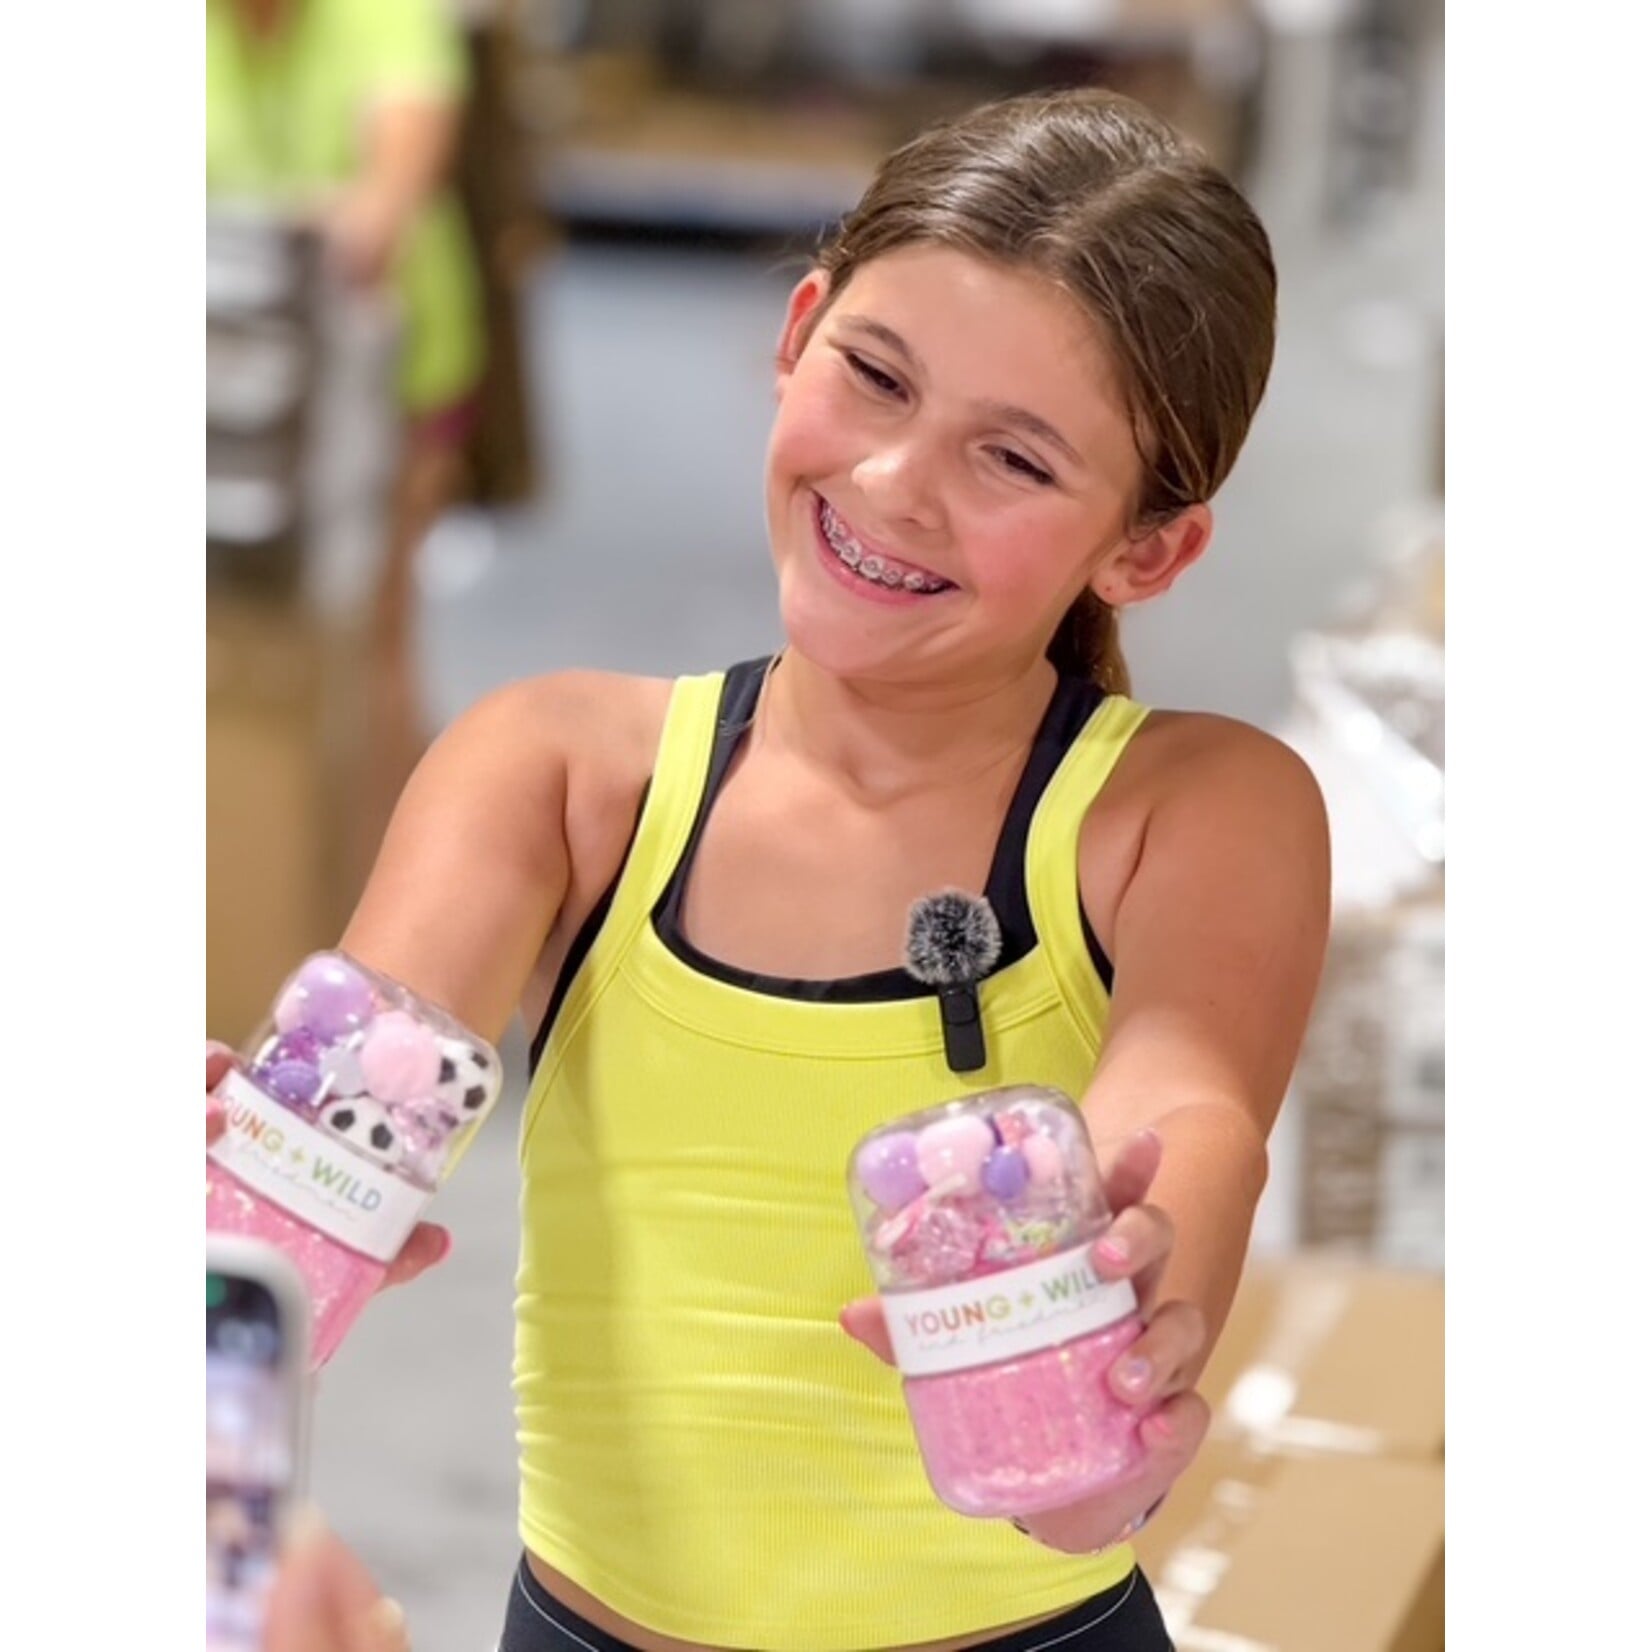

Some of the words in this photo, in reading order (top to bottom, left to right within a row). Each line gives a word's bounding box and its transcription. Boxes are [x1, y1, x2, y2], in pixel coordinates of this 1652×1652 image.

[311, 1156, 382, 1211] WILD
[904, 1293, 1011, 1337] YOUNG
[1041, 1269, 1104, 1302] WIL
